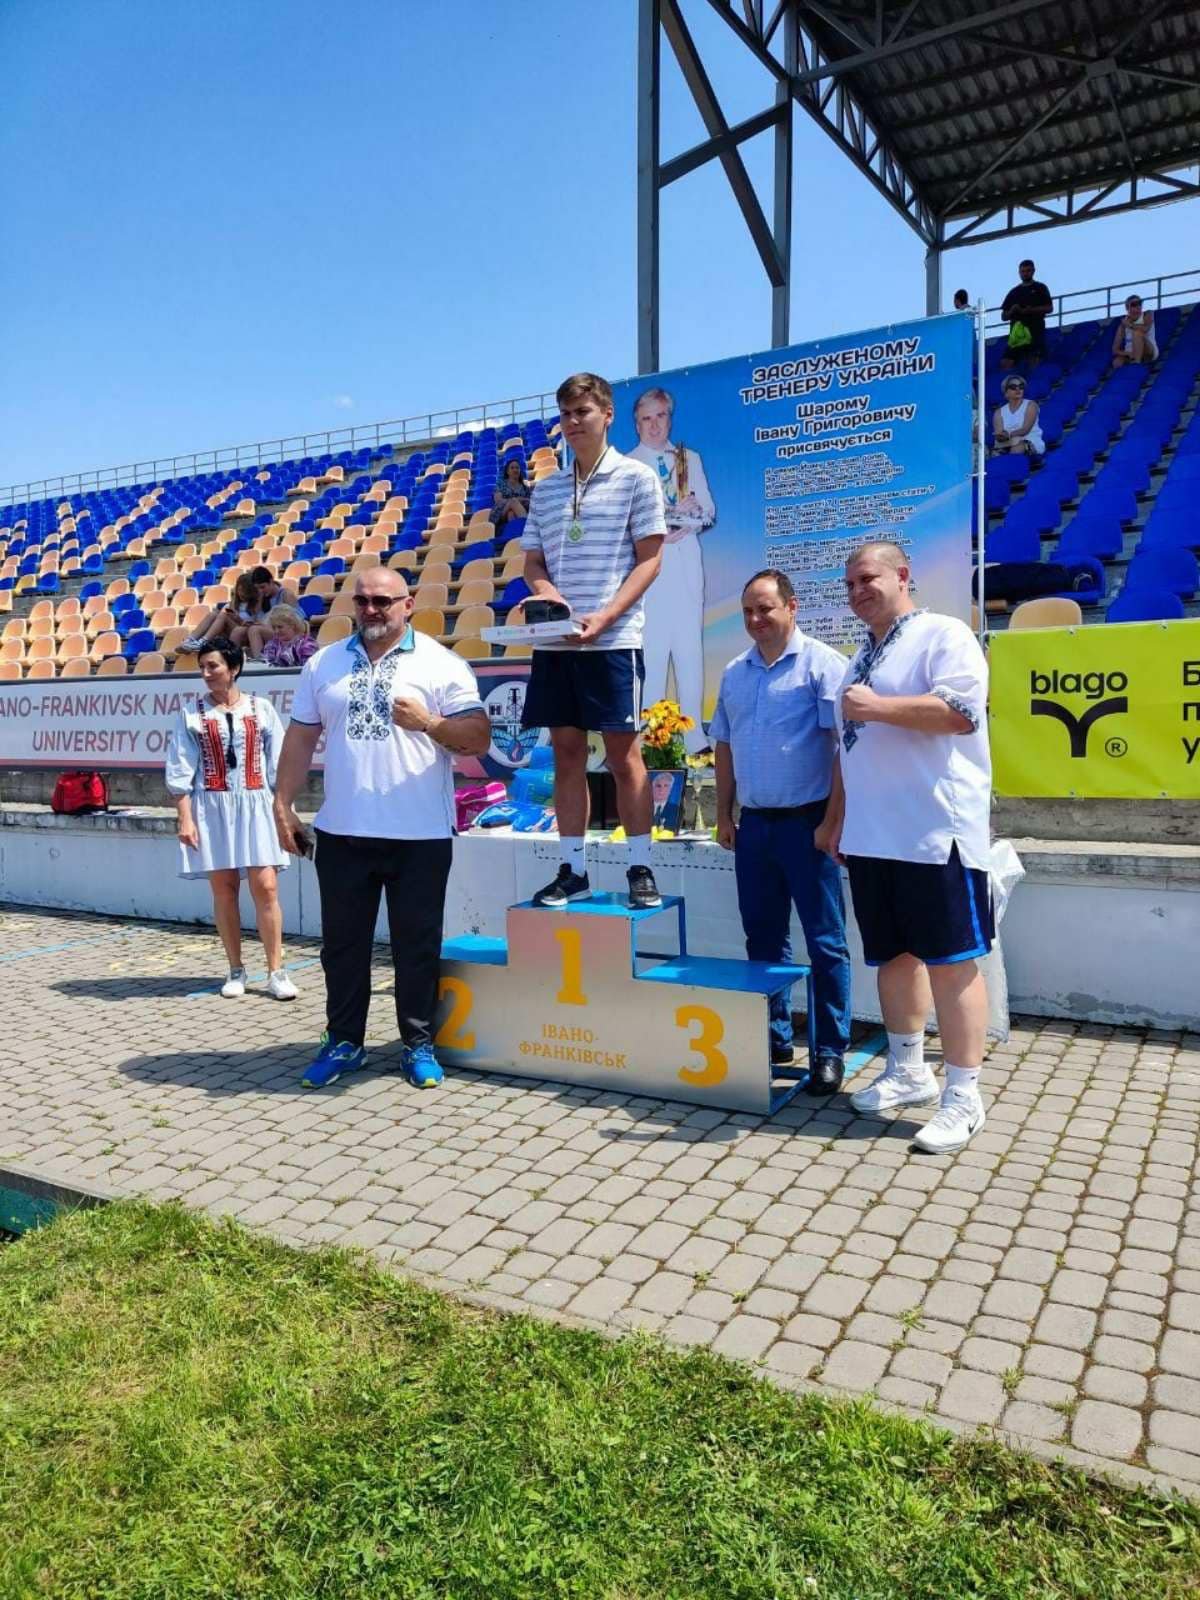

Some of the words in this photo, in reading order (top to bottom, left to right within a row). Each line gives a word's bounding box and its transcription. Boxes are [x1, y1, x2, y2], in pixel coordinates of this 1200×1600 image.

[754, 337, 920, 383] ЗАСЛУЖЕНОМУ
[742, 374, 832, 404] ТРЕНЕРУ
[839, 354, 935, 387] УКРАЇНИ
[755, 425, 799, 441] Івану
[804, 406, 915, 434] Григоровичу
[798, 396, 869, 418] Шарому
[778, 430, 891, 456] присвячується
[1031, 670, 1128, 699] blago
[33, 730, 139, 752] UNIVERSITY
[556, 928, 588, 1006] 1
[434, 976, 476, 1050] 2
[519, 1040, 627, 1069] ФРАНКІВСЬК
[675, 1005, 729, 1088] 3
